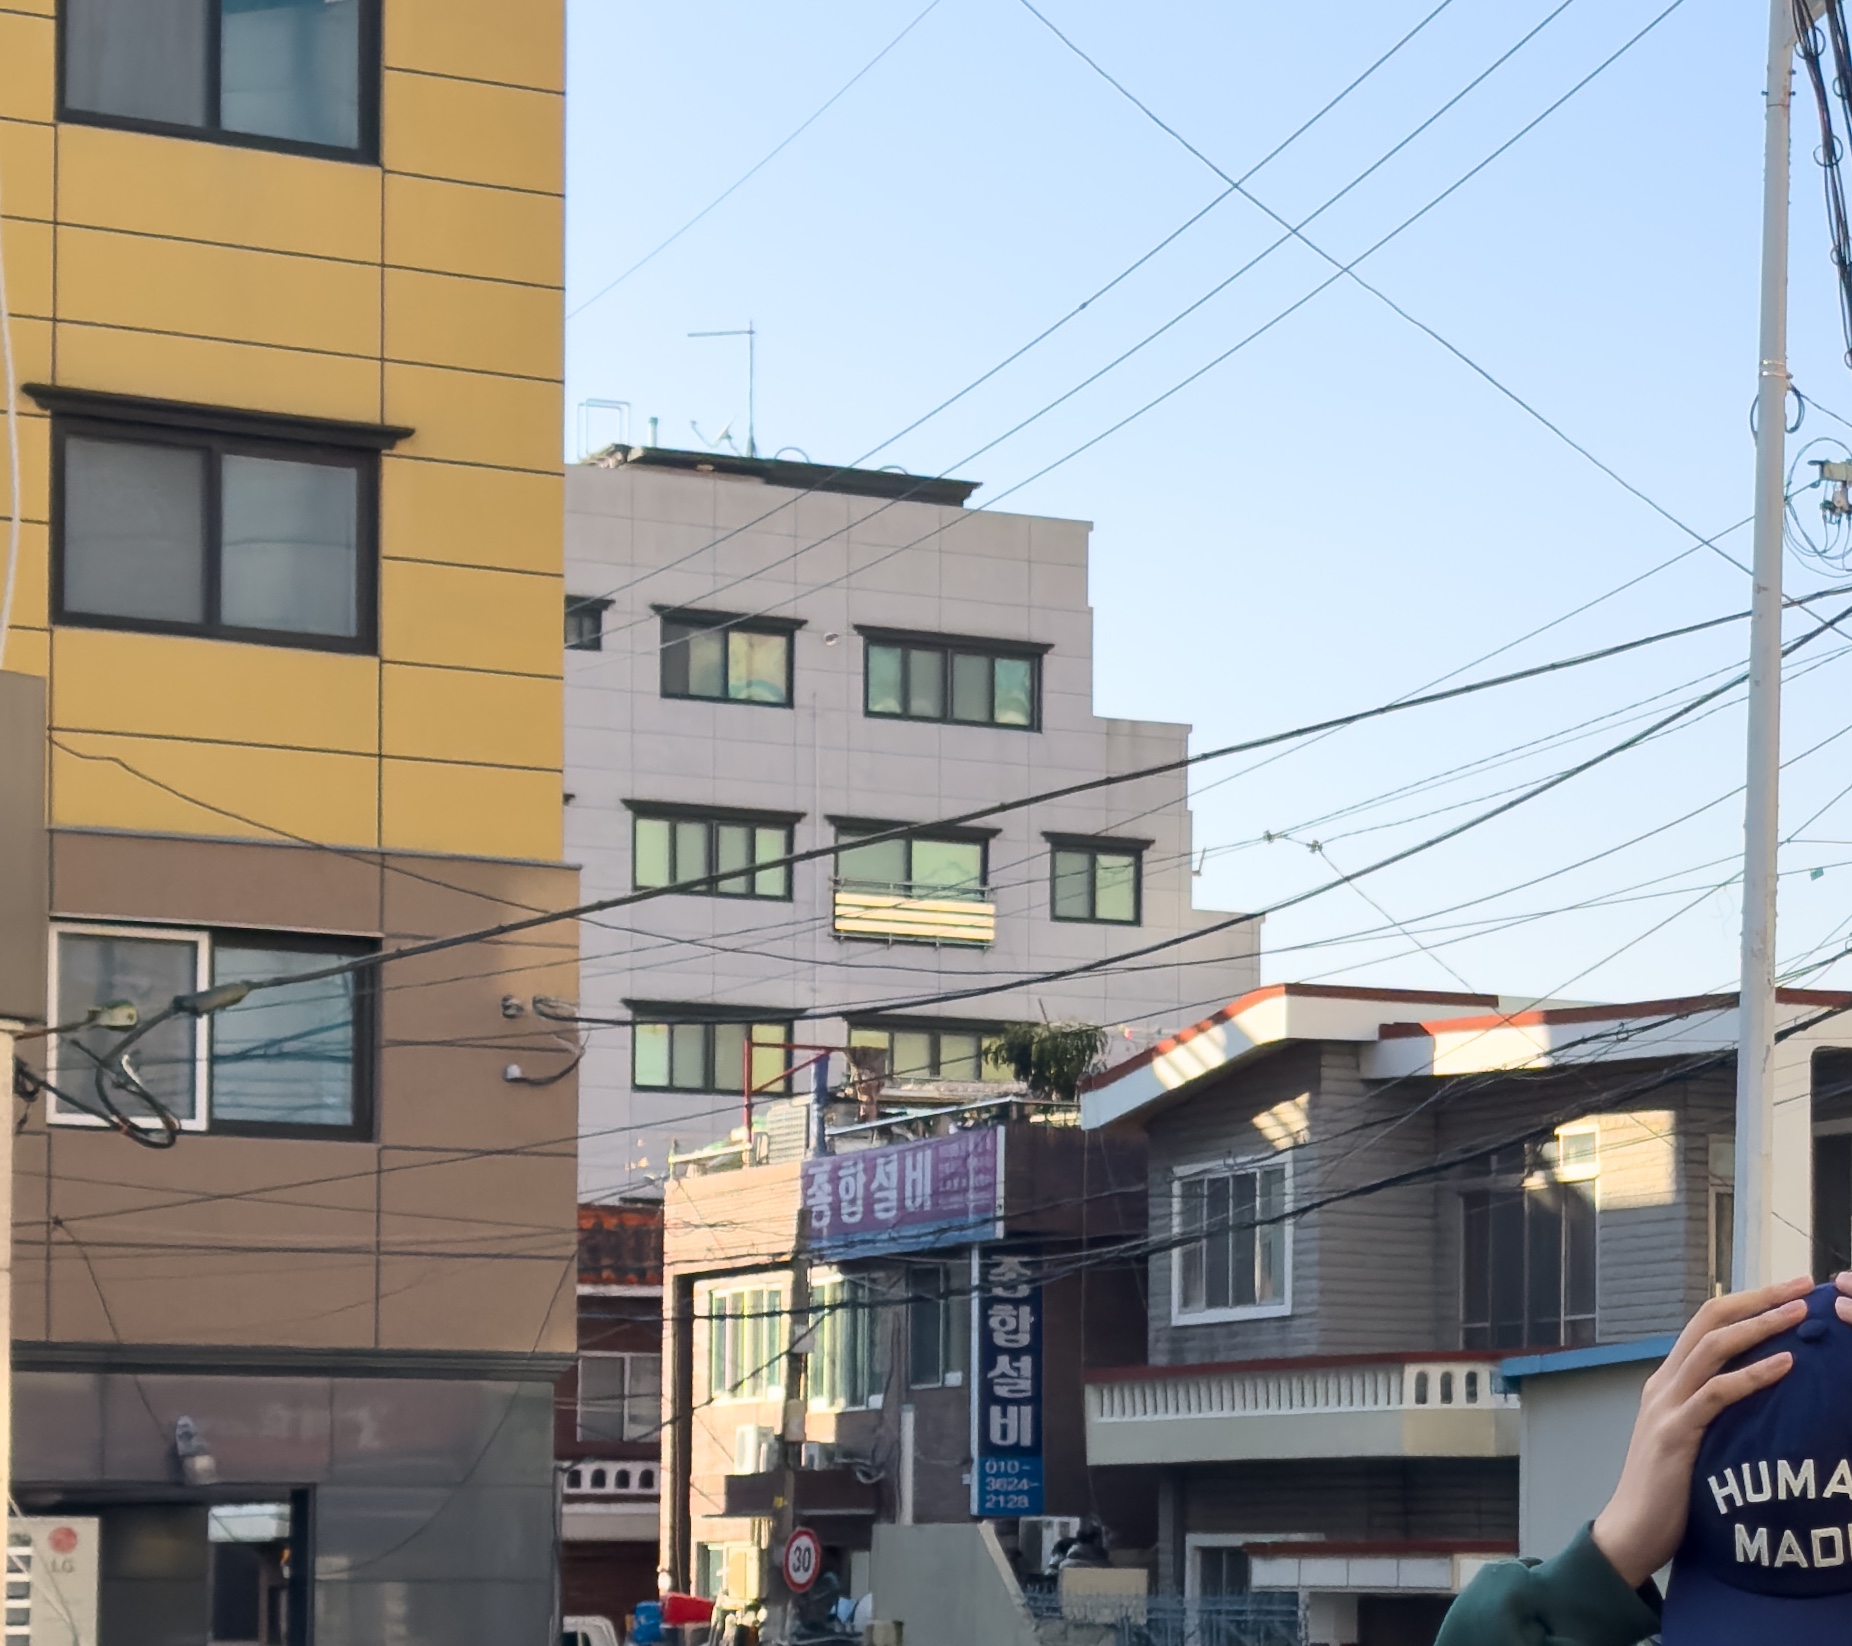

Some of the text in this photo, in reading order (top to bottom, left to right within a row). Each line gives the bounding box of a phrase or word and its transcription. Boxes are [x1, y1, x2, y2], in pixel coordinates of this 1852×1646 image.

[806, 1149, 932, 1229] 종합설비
[987, 1255, 1035, 1447] 종합설비
[792, 1545, 812, 1573] 30
